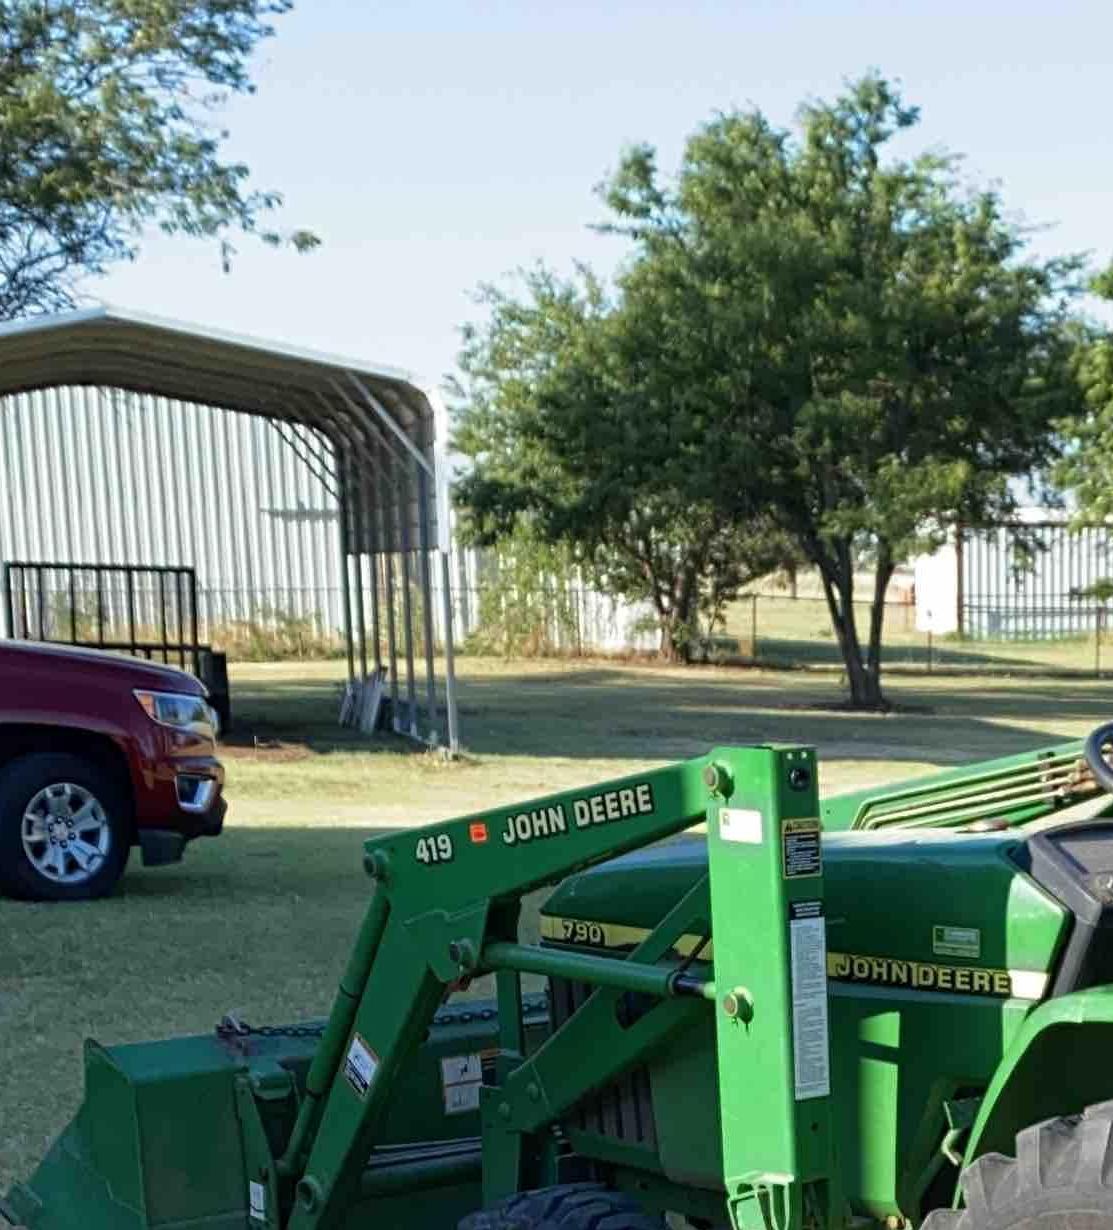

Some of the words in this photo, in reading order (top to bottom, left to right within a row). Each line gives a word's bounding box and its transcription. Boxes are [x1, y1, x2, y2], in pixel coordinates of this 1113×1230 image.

[502, 805, 567, 844] JOHN
[573, 784, 653, 828] DEERE
[415, 834, 453, 863] 419
[562, 920, 602, 943] 790
[837, 956, 909, 987] JOHN
[916, 963, 1012, 994] DEERE
